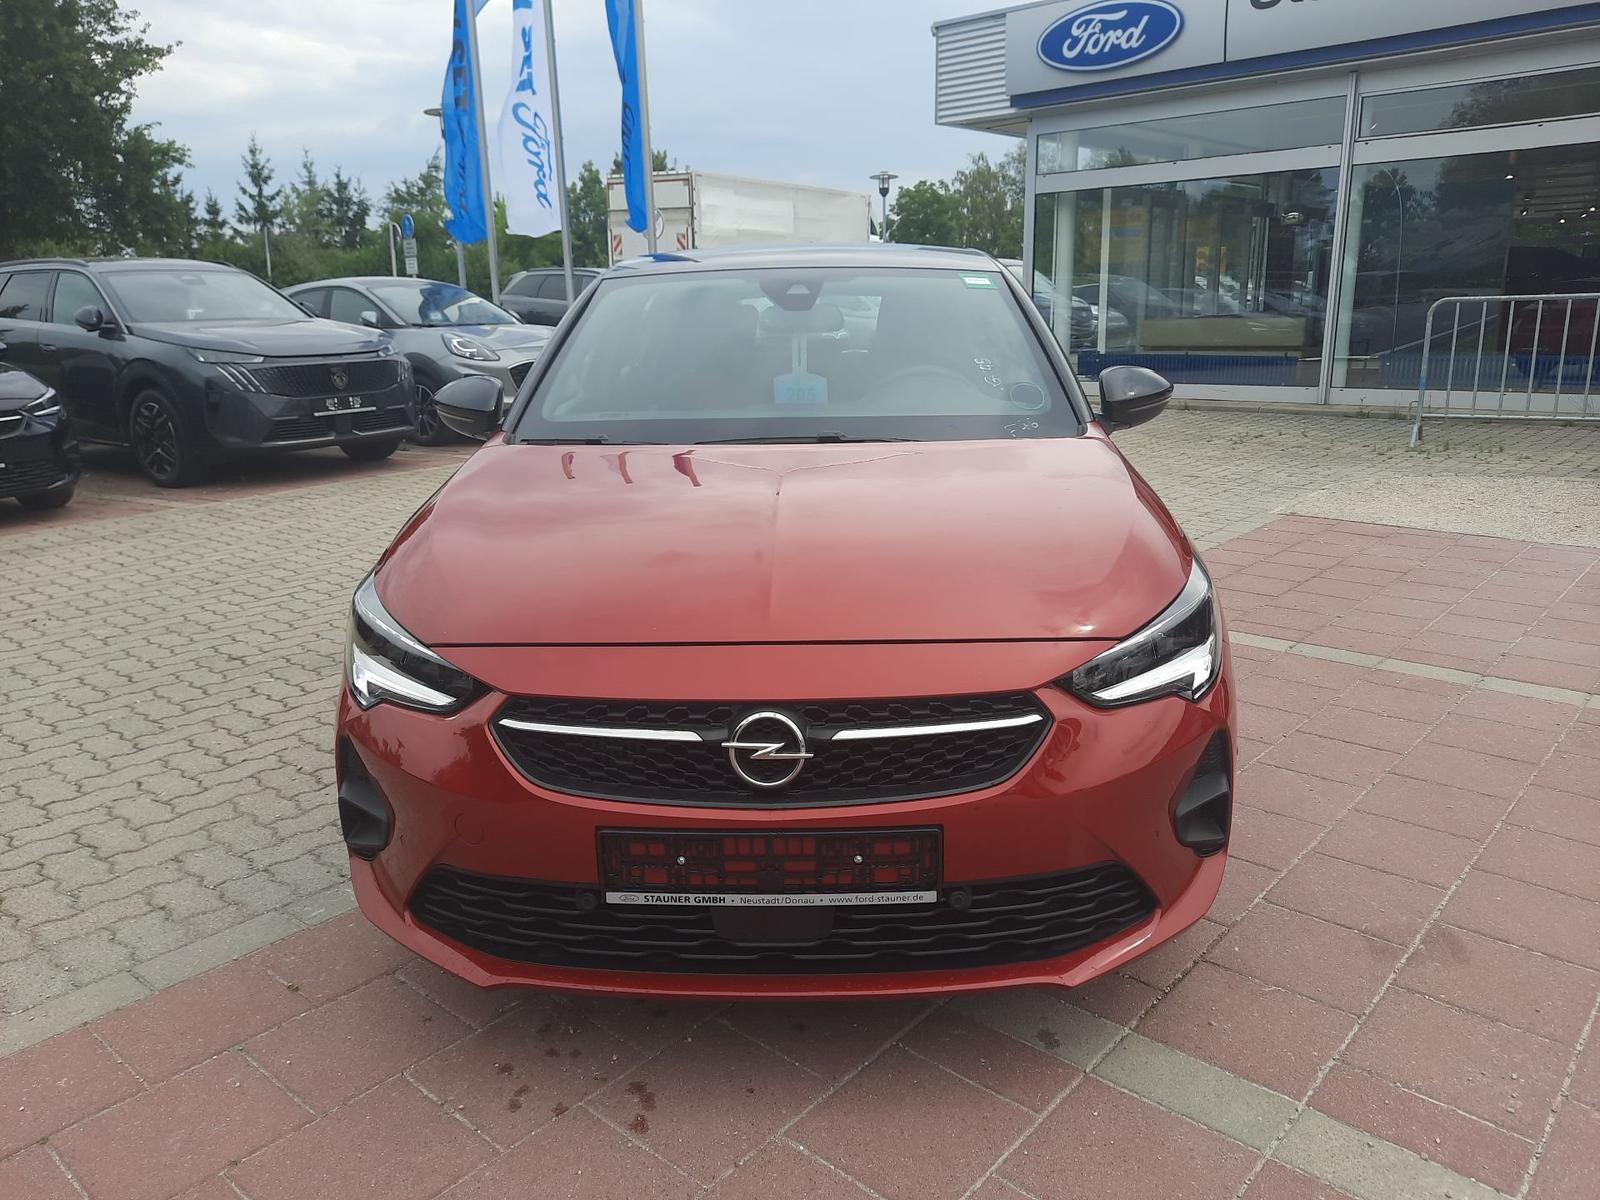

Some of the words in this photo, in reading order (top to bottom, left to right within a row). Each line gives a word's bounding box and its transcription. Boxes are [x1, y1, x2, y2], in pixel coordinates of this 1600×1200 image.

[1063, 9, 1150, 58] Ford
[511, 101, 553, 210] Ford
[643, 894, 691, 904] STAUNER
[693, 895, 726, 905] GMBH
[740, 896, 815, 906] Neustadt/Donau
[828, 893, 924, 905] www.ford-stauner.de
